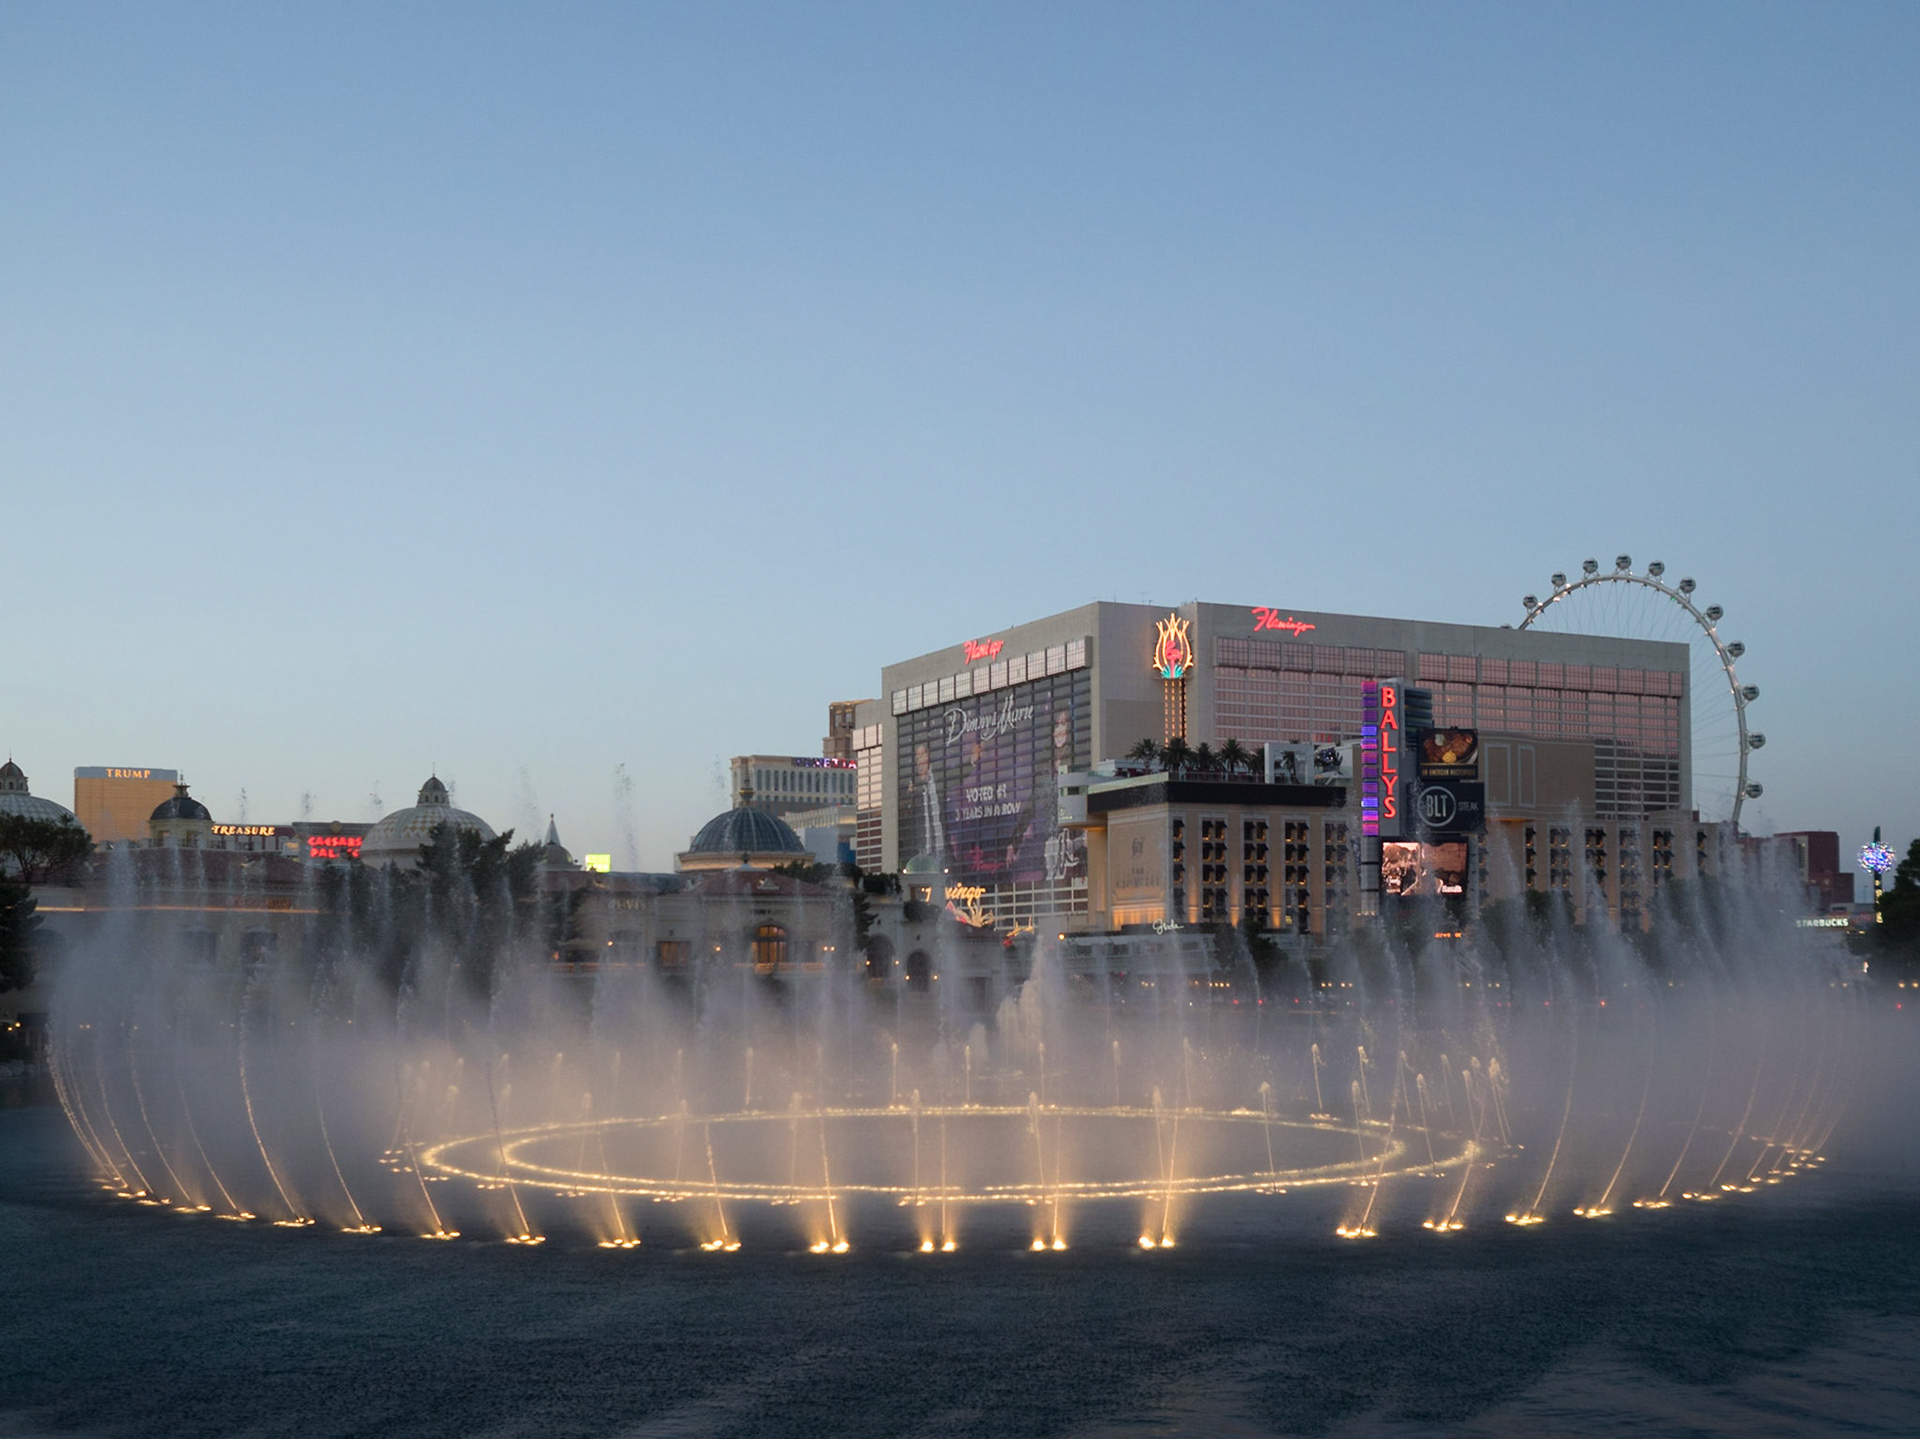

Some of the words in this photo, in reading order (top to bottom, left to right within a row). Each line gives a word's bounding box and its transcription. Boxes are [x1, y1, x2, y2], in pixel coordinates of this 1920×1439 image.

[1251, 607, 1315, 637] Flamingo
[963, 638, 1004, 666] Flamingo
[1380, 686, 1398, 818] BALLYS
[106, 768, 151, 779] TRUMP
[966, 785, 994, 802] VOTED
[962, 805, 984, 820] YEARS
[984, 804, 992, 818] IN
[1002, 801, 1021, 818] ROW
[1426, 795, 1448, 818] BLT
[1458, 802, 1478, 812] STEAK
[212, 825, 275, 836] TREASURE
[307, 836, 362, 847] CAESARS
[1796, 918, 1849, 928] STARBUCKS
